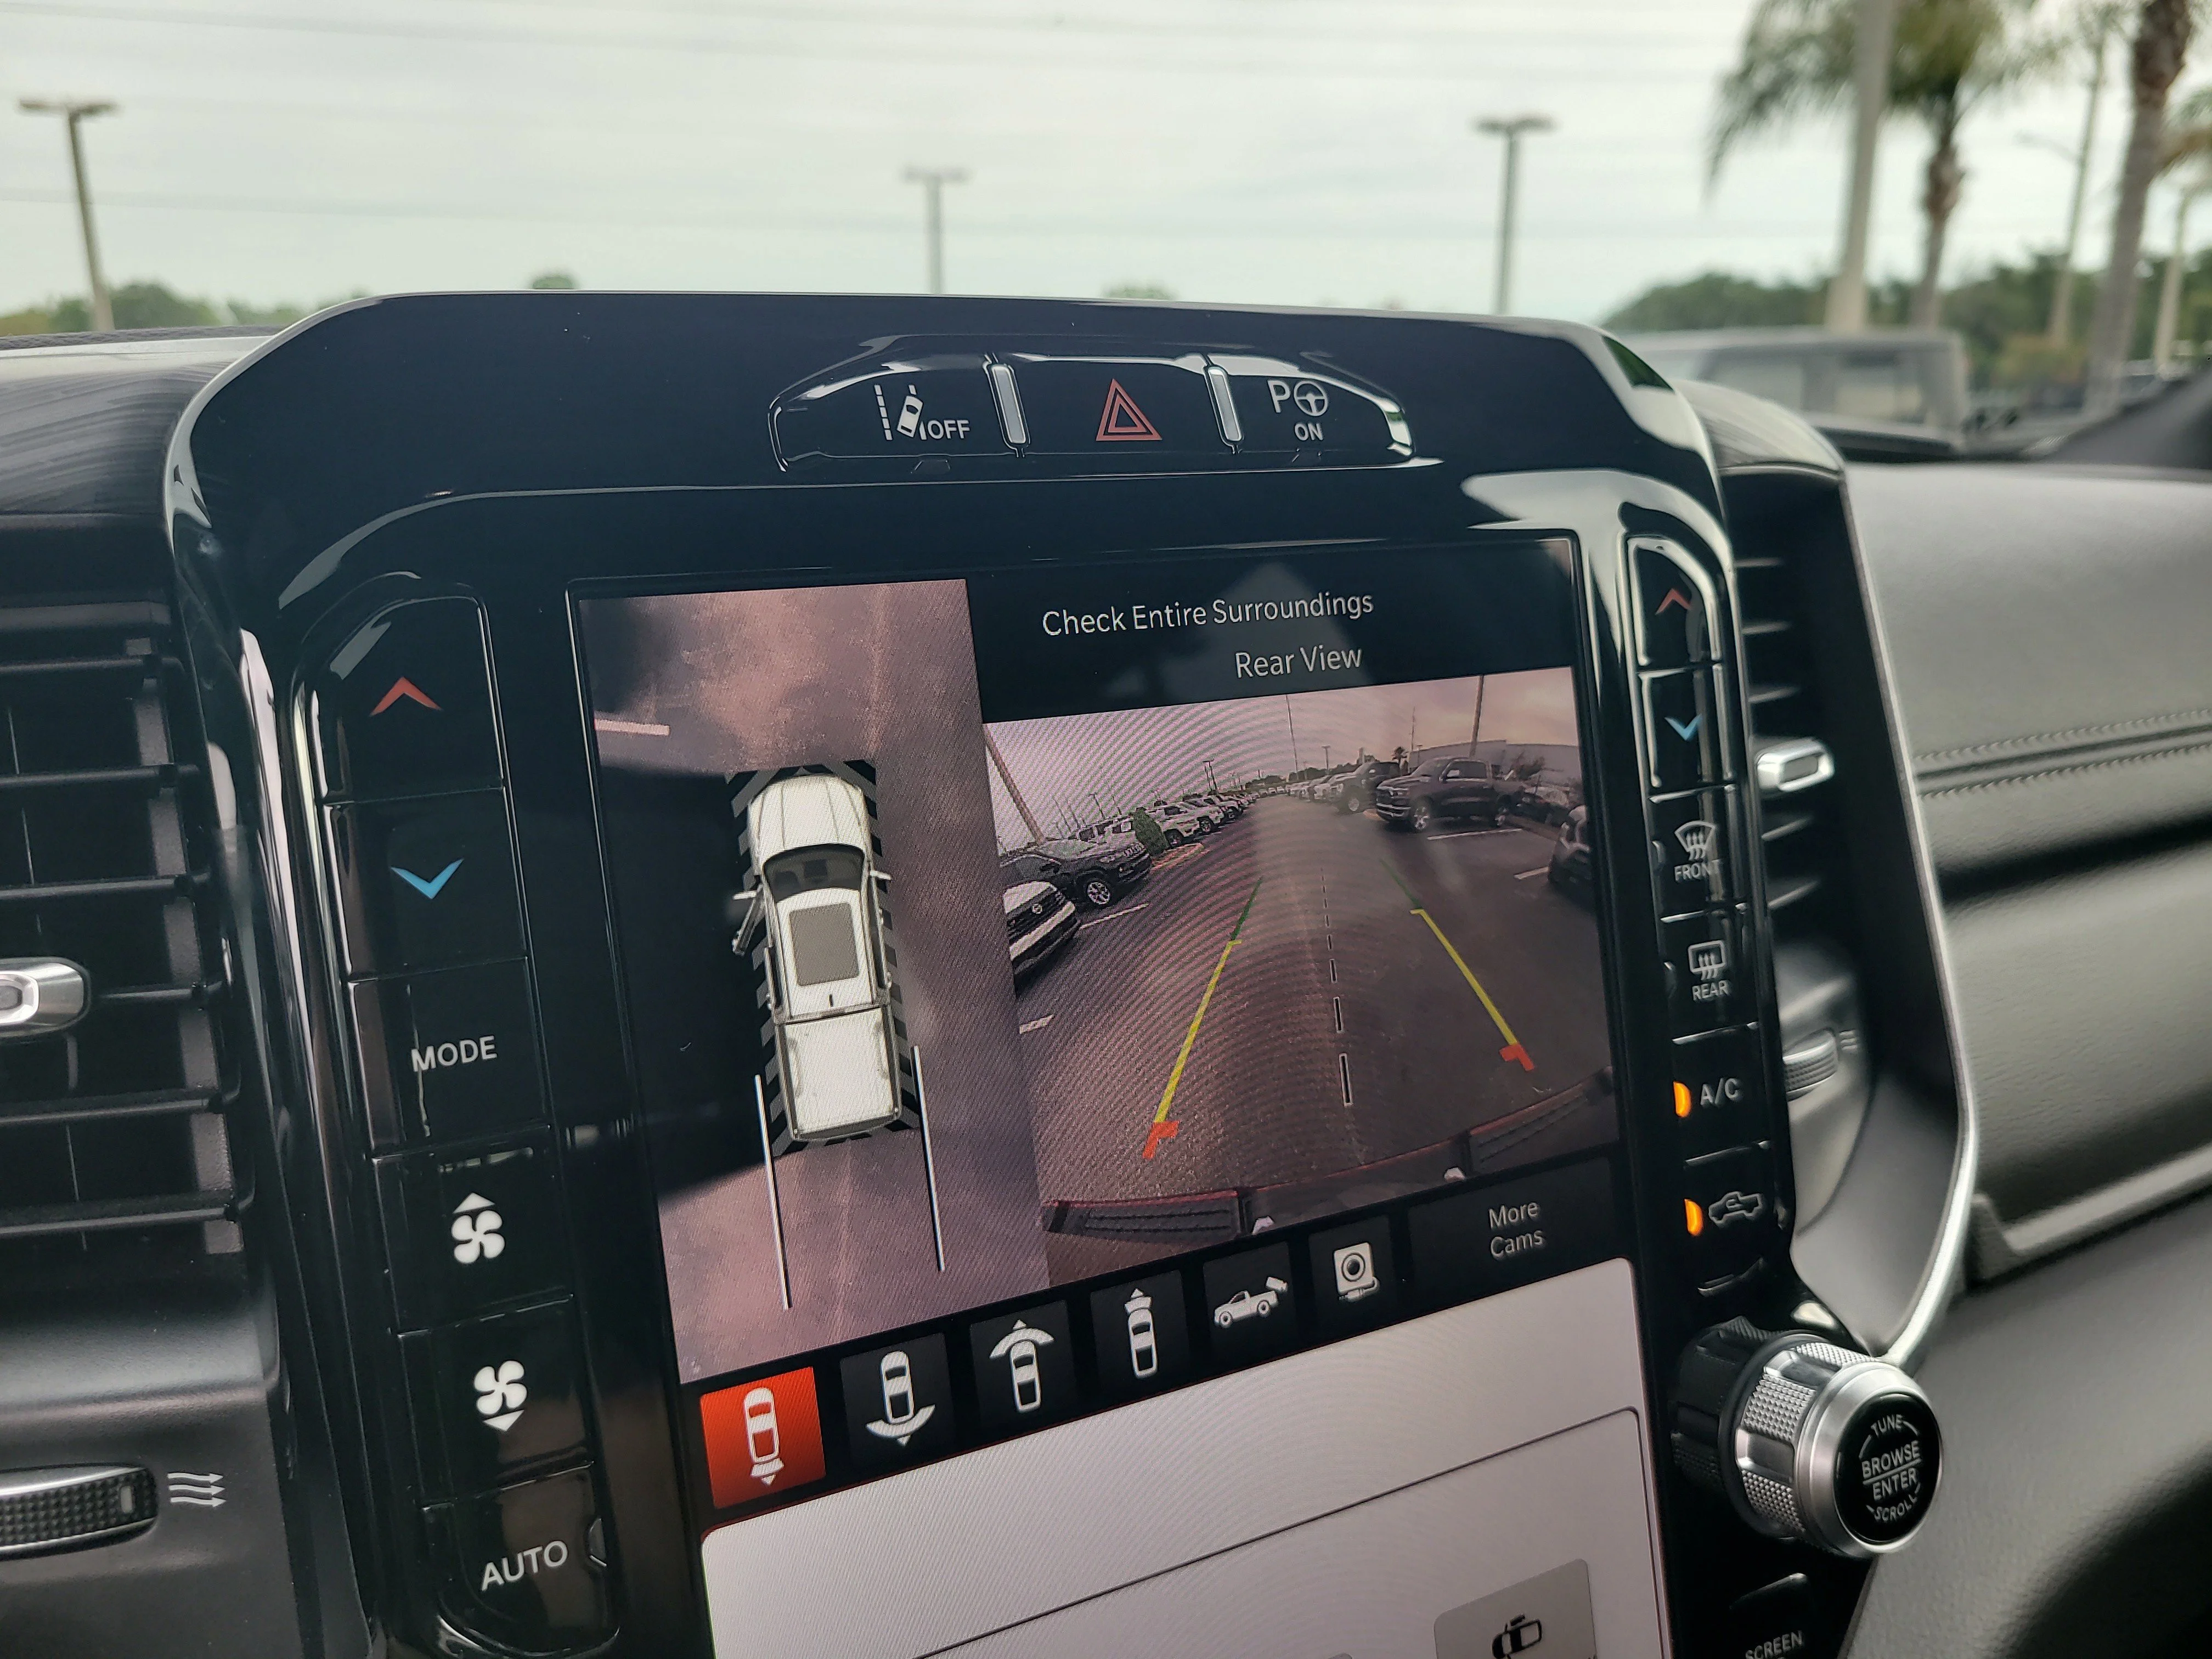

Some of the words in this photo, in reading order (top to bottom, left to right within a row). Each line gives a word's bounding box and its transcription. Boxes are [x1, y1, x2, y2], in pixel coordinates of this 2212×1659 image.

[927, 420, 970, 439] OFF
[1294, 422, 1324, 441] ON
[1042, 606, 1126, 636] Check
[1133, 601, 1206, 630] Entire
[1212, 592, 1374, 624] Surroundings
[1235, 652, 1294, 678] Rear
[1300, 645, 1362, 672] View
[1674, 859, 1722, 882] FRONT
[1692, 980, 1729, 1001] REAR
[411, 1035, 498, 1072] MODE
[1701, 1077, 1741, 1106] A/C
[1488, 1201, 1539, 1229] More
[1490, 1230, 1544, 1259] Cams
[1871, 1414, 1904, 1437] TUNE
[1862, 1440, 1921, 1479] BROWSE
[1872, 1468, 1919, 1501] ENTER
[1873, 1493, 1918, 1522] SCROLL
[481, 1540, 568, 1591] AUTO
[1745, 1630, 1803, 1659] SCREEN
